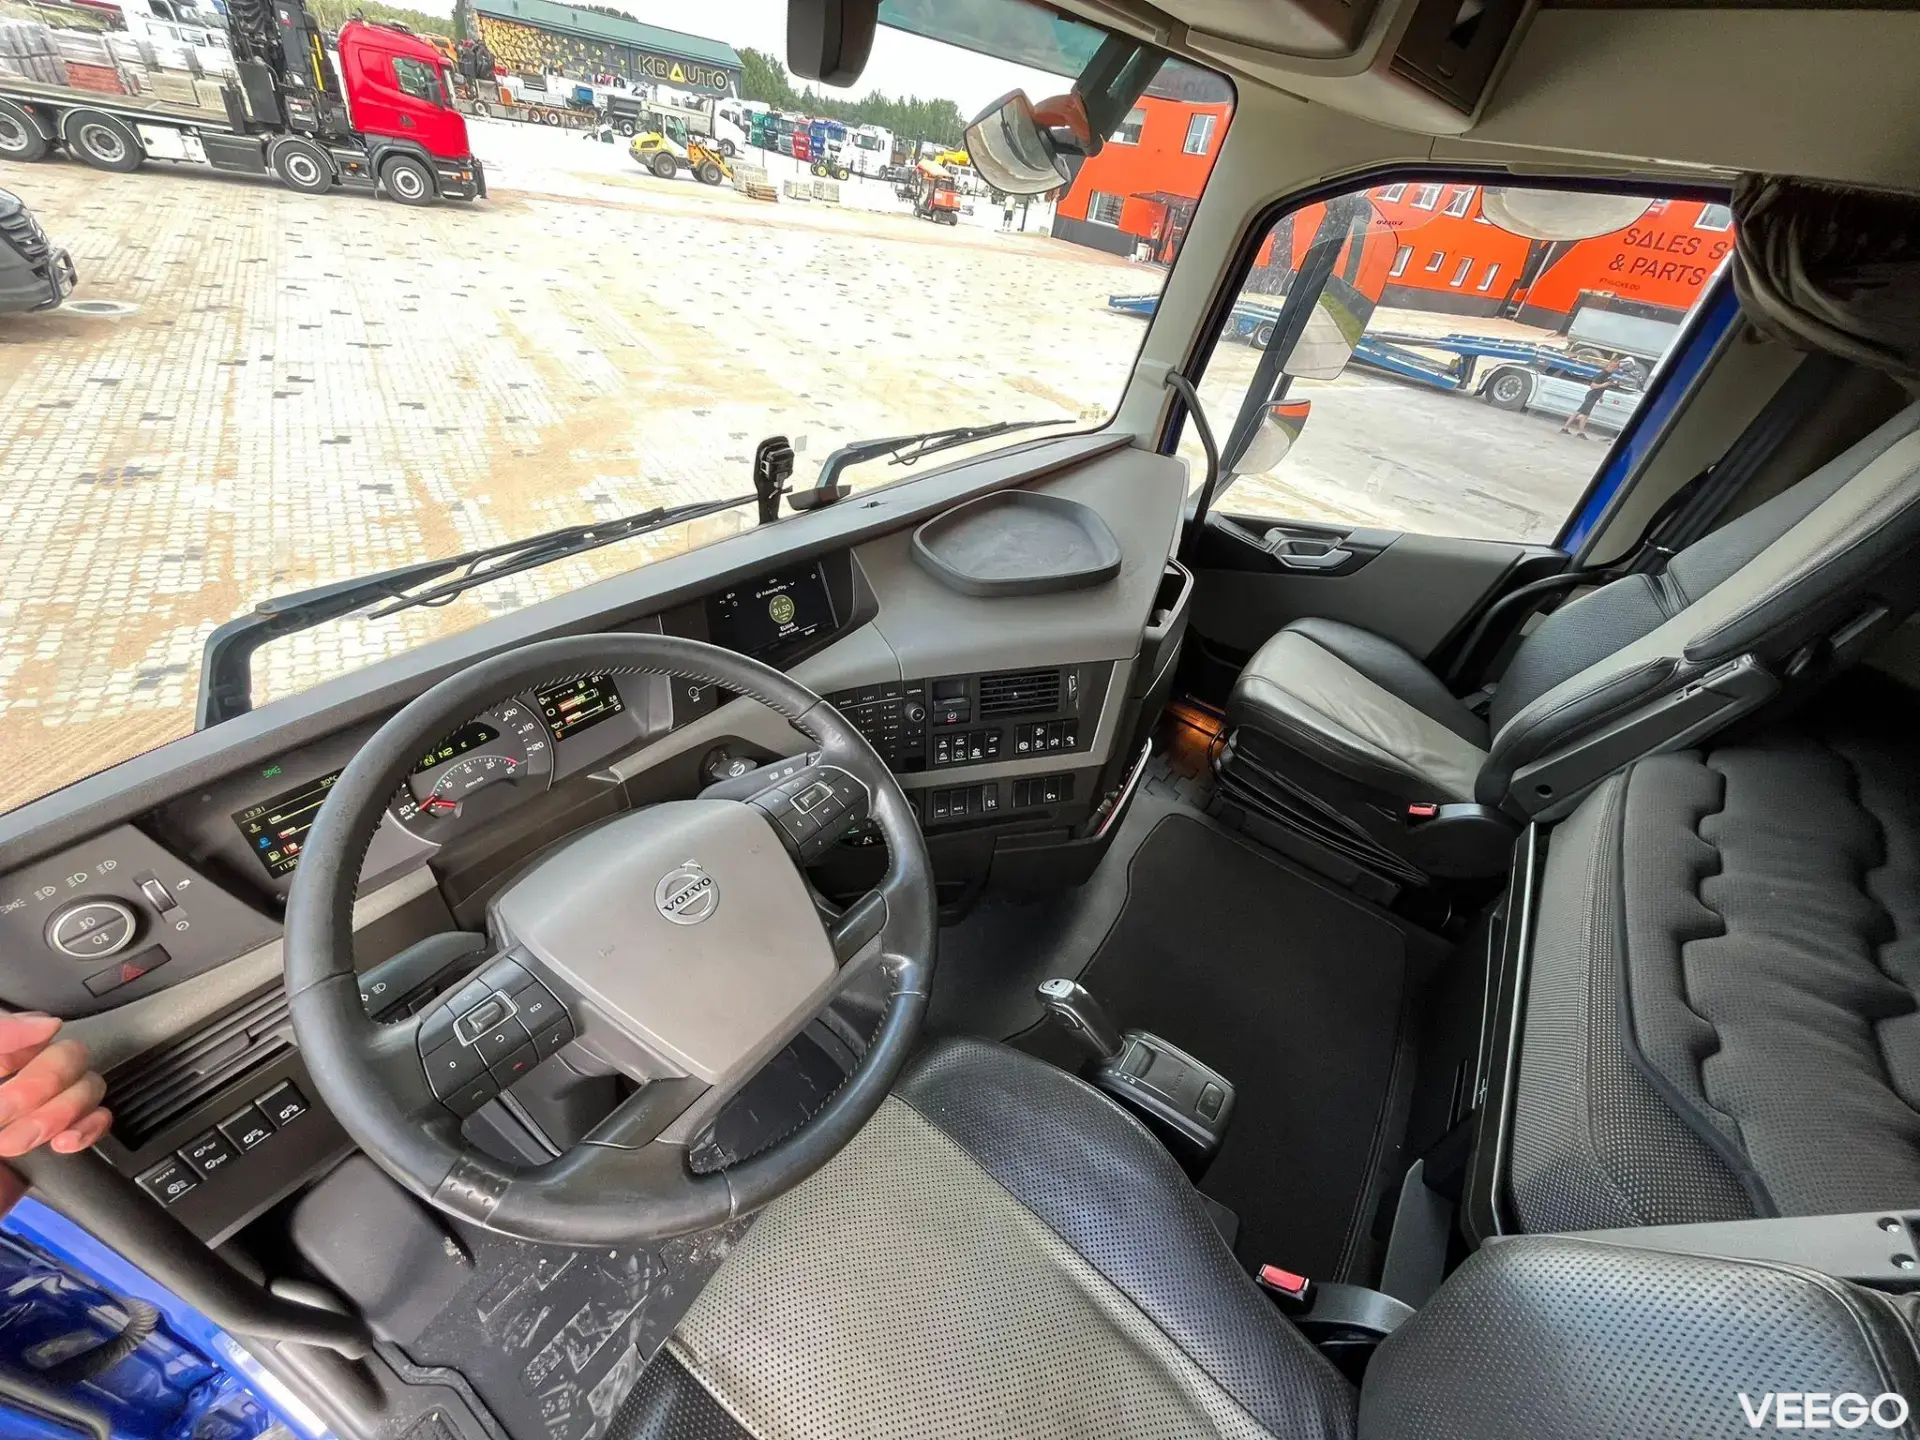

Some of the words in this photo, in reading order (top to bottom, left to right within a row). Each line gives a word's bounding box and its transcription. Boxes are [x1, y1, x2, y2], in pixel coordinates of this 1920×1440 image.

[1623, 227, 1702, 255] SALES
[1608, 253, 1625, 271] &
[1629, 256, 1707, 285] PARTS
[503, 707, 518, 717] 100
[522, 722, 534, 732] 110
[531, 741, 545, 751] 120
[464, 766, 472, 774] 15
[485, 761, 495, 770] 20
[444, 781, 453, 789] 10
[398, 804, 411, 816] 20
[663, 877, 712, 912] VOLVO
[529, 1002, 542, 1013] ECO
[154, 1167, 176, 1184] AUTO
